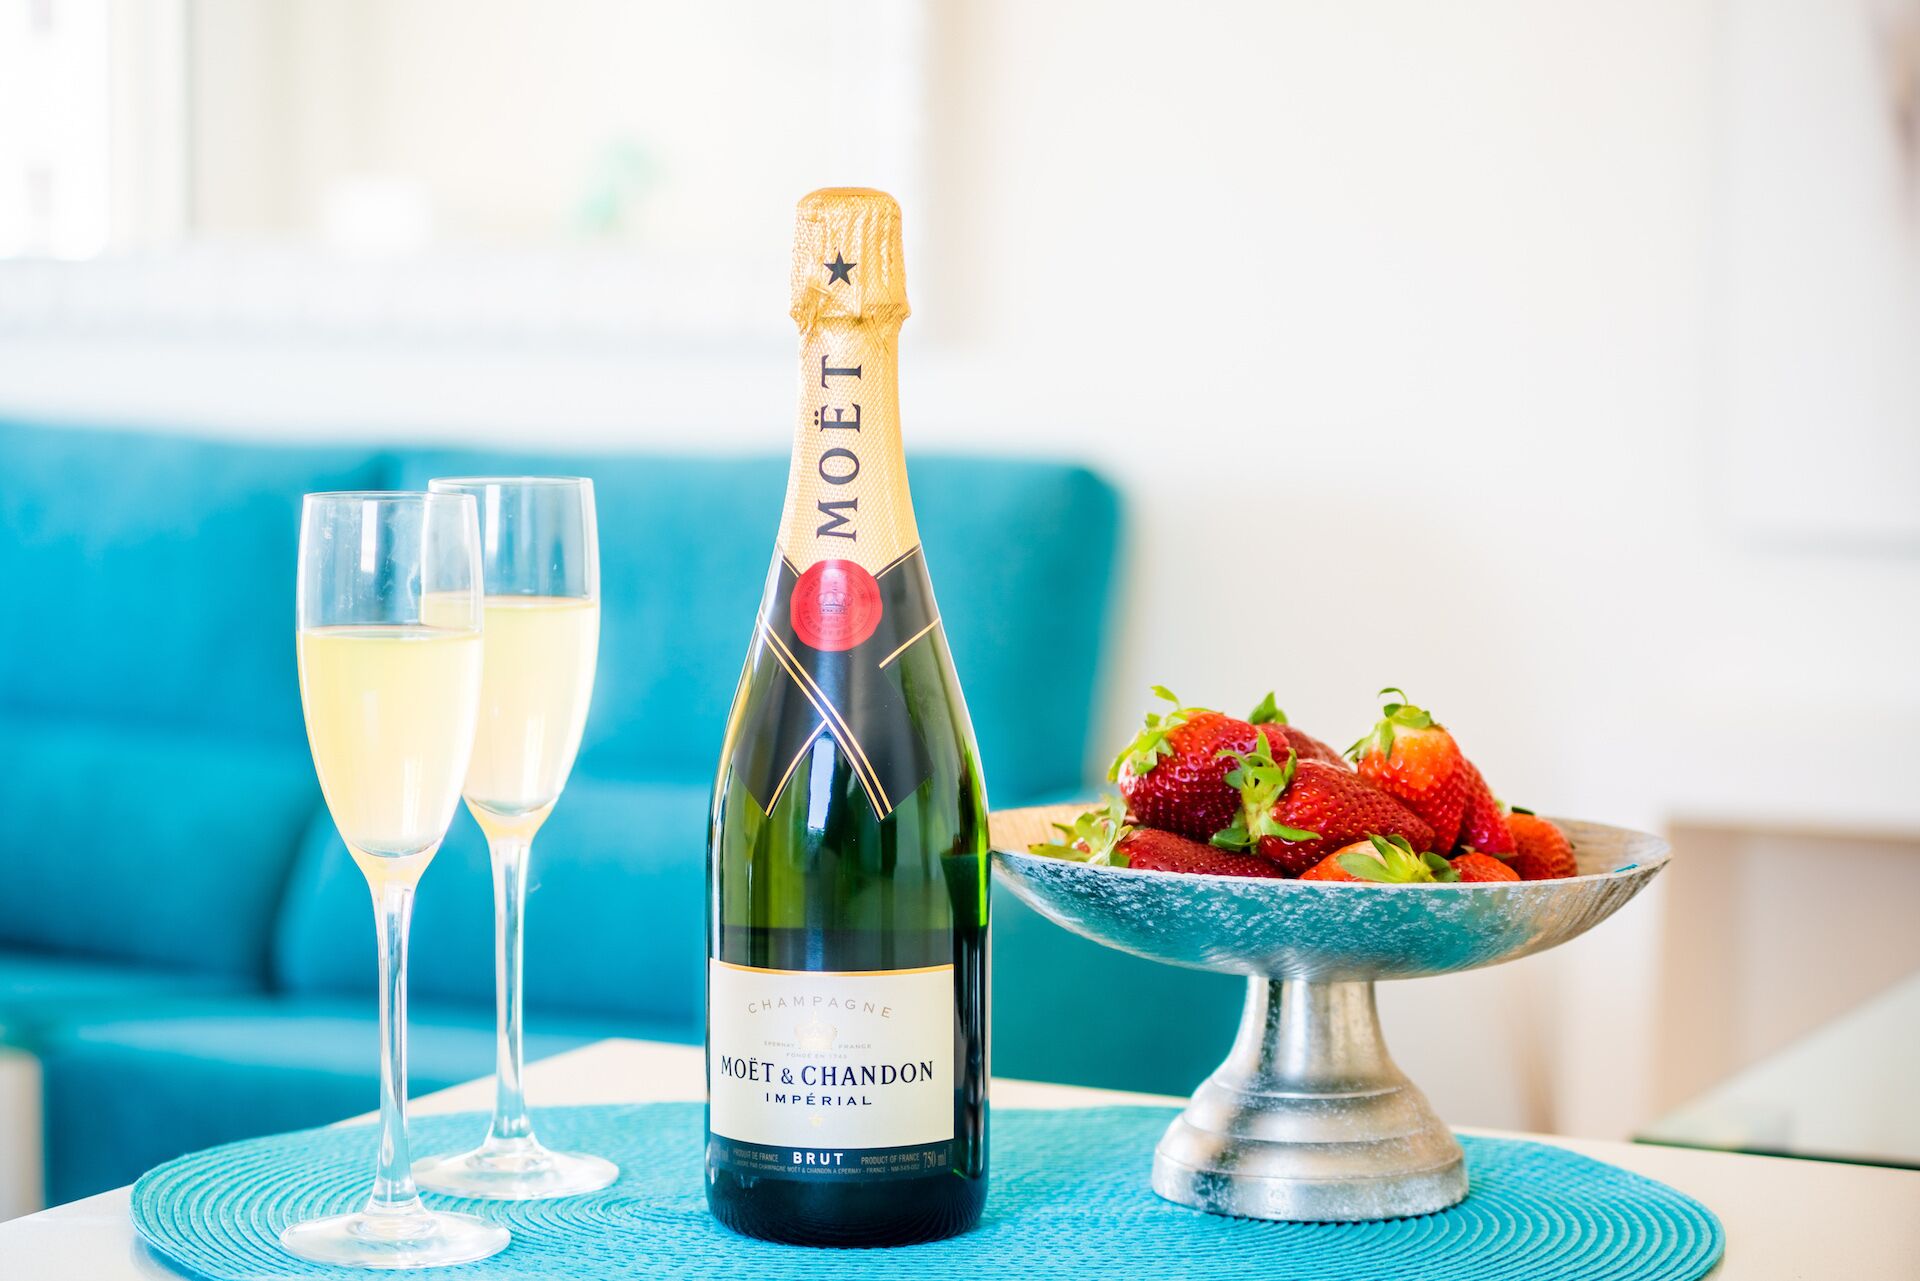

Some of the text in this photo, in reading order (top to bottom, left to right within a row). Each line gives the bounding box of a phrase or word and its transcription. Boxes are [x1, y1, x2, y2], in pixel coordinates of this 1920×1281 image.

[814, 354, 862, 543] MOËT
[747, 995, 893, 1019] CHAMPAGNE
[721, 1054, 935, 1086] MOËT & CHANDON
[765, 1092, 873, 1106] IMPÉRIAL
[759, 1152, 779, 1163] FRANCE
[792, 1151, 844, 1165] BRUT
[861, 1152, 920, 1165] PRODUCT OF FRANCE
[922, 1151, 937, 1169] 750
[866, 1166, 886, 1174] FRANCE
